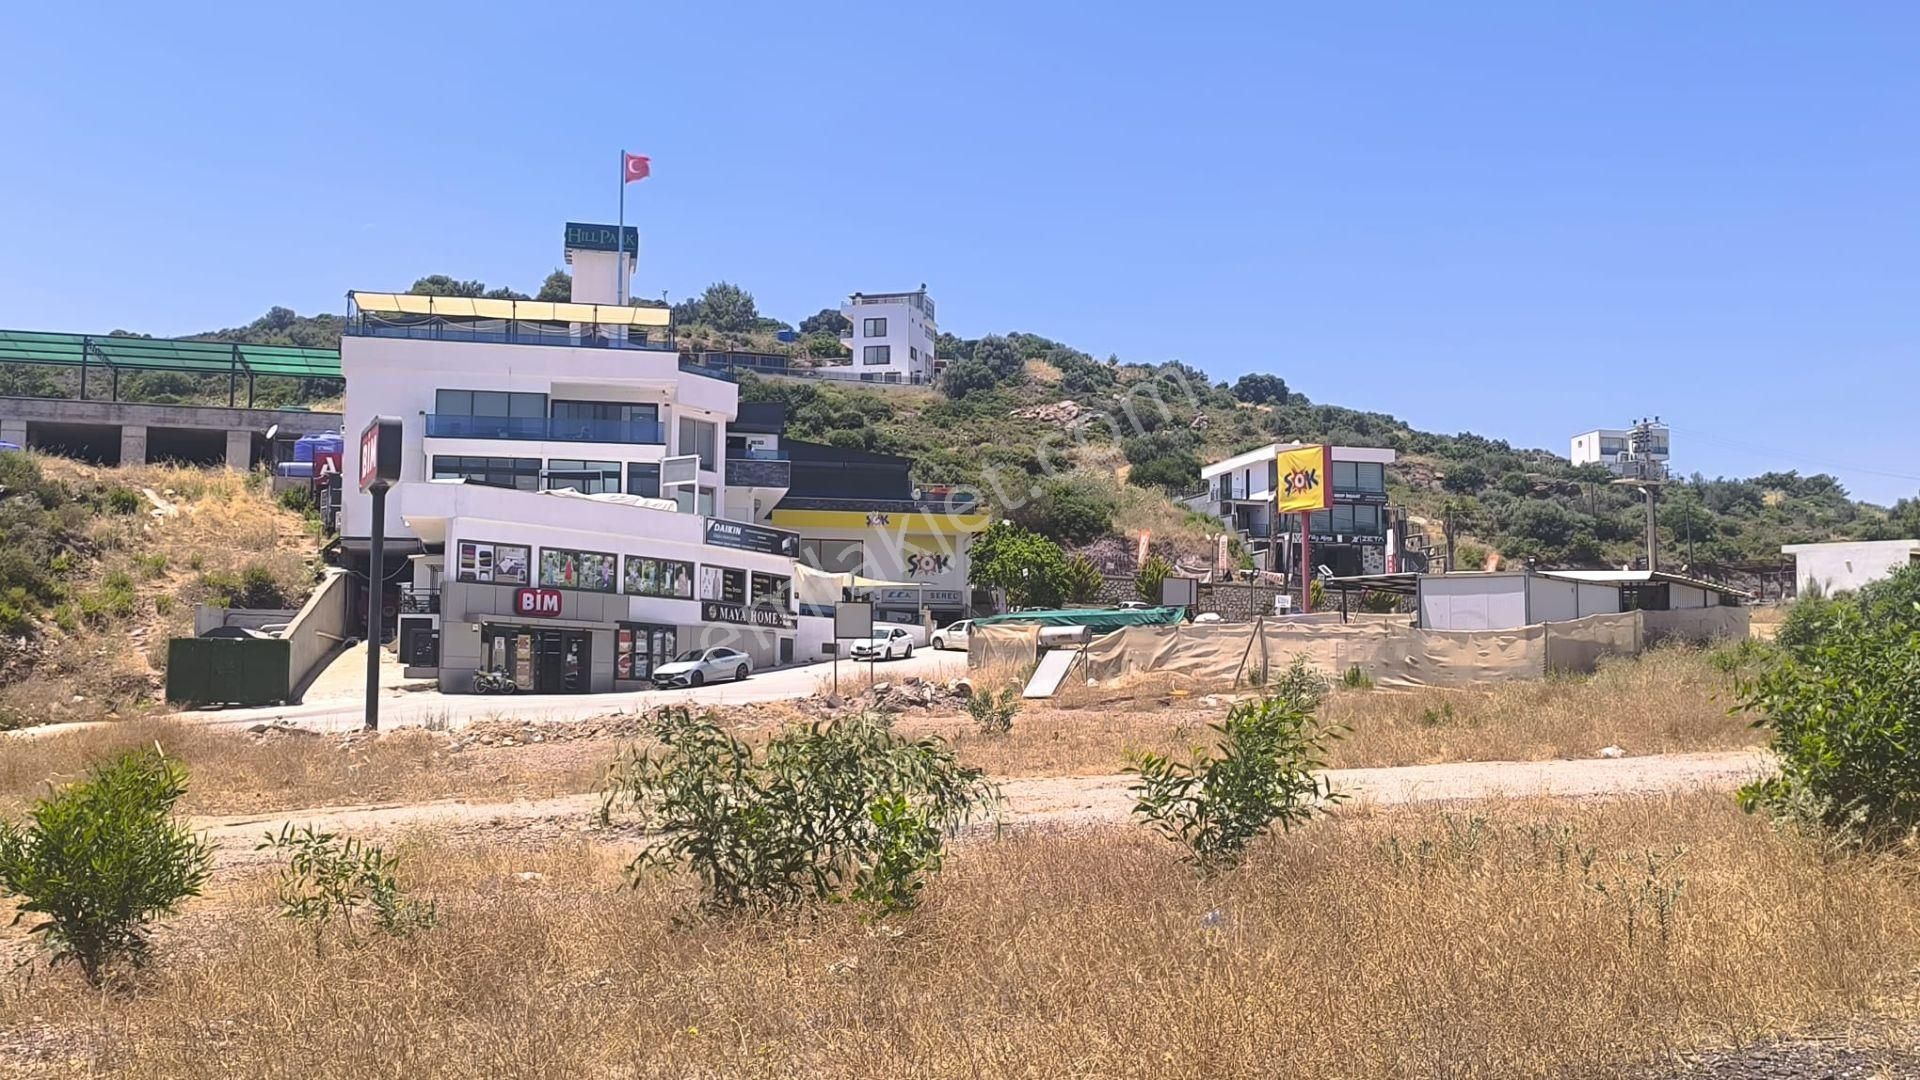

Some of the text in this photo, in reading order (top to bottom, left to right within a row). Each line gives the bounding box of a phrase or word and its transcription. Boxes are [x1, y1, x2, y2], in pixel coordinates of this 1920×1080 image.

[600, 229, 636, 247] PAK
[714, 522, 742, 536] DAIKIN
[522, 589, 558, 612] BİM
[720, 606, 747, 621] MAYA
[750, 610, 778, 625] HOME
